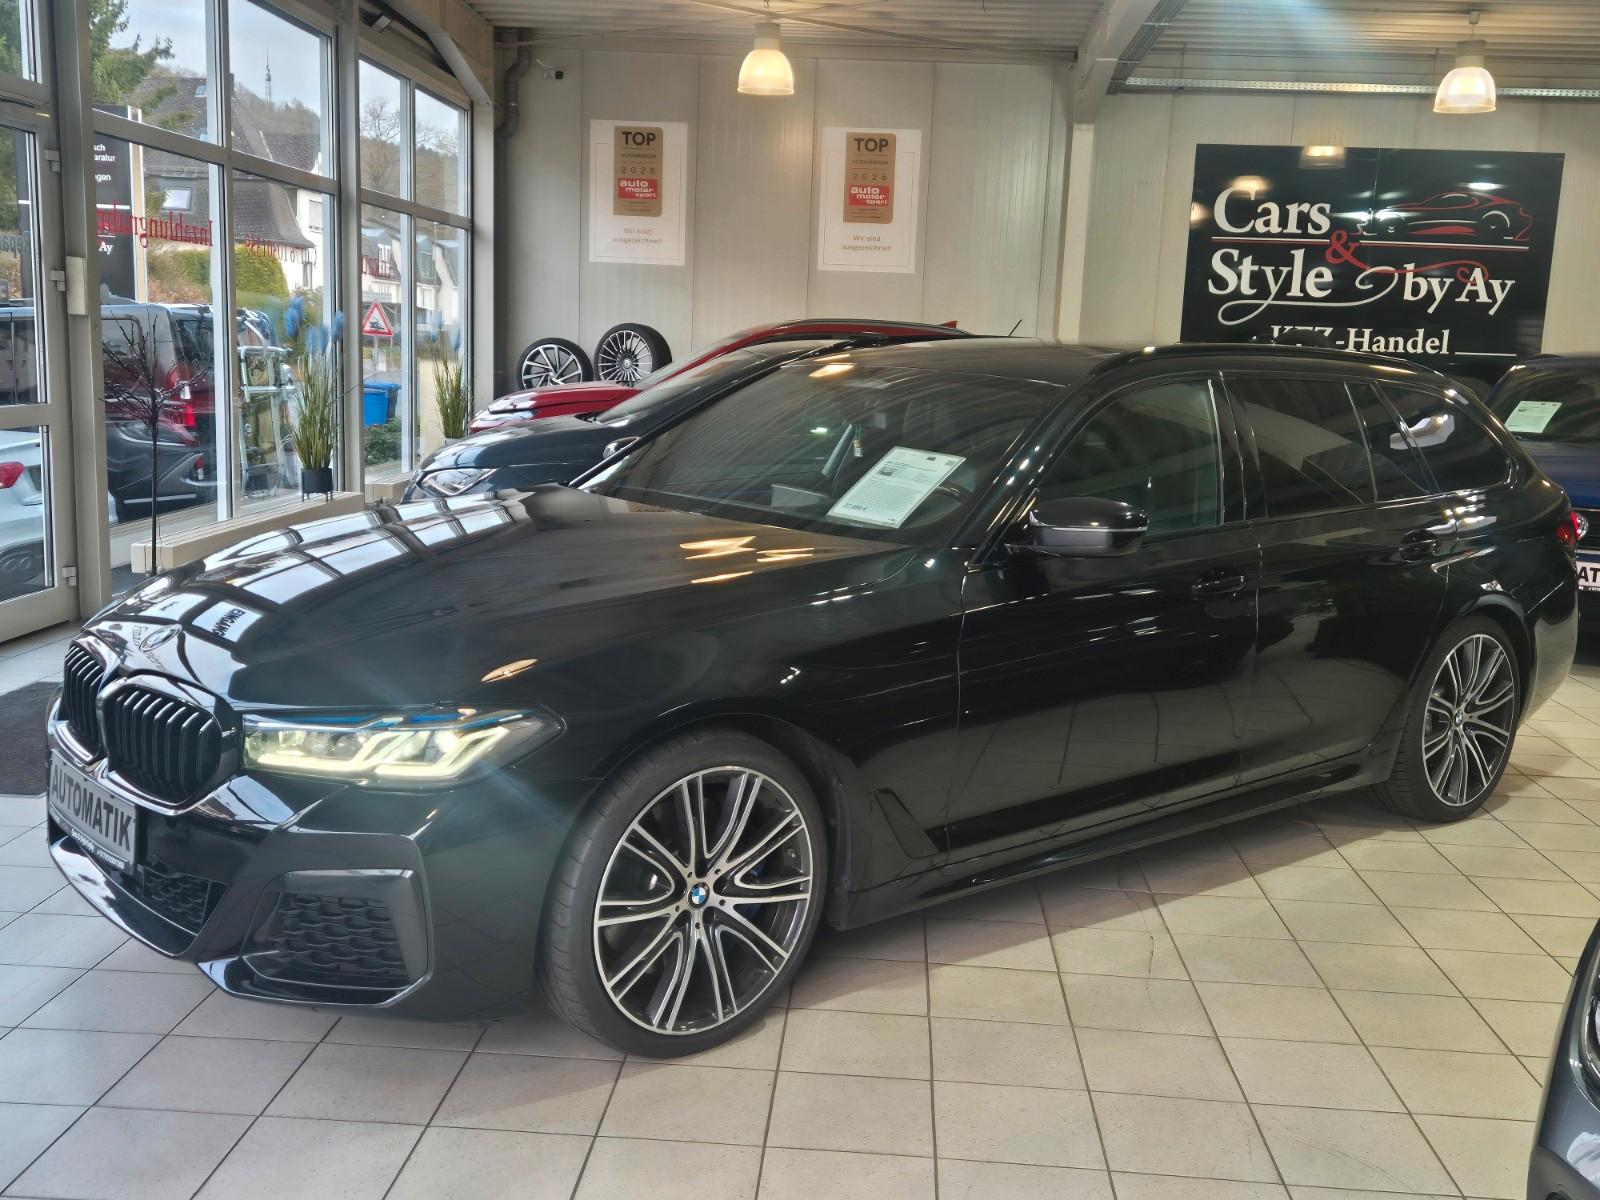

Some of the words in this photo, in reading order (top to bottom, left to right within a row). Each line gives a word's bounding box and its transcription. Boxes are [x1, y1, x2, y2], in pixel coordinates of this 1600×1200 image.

[622, 131, 656, 146] TOP
[854, 137, 889, 152] TOP
[619, 179, 649, 188] auto
[850, 186, 880, 195] auto
[1213, 186, 1331, 236] Cars
[98, 241, 113, 255] Ay
[1207, 248, 1333, 316] Style
[1403, 262, 1455, 314] by
[1455, 266, 1516, 316] Ay
[51, 765, 132, 852] AUTOMATIK
